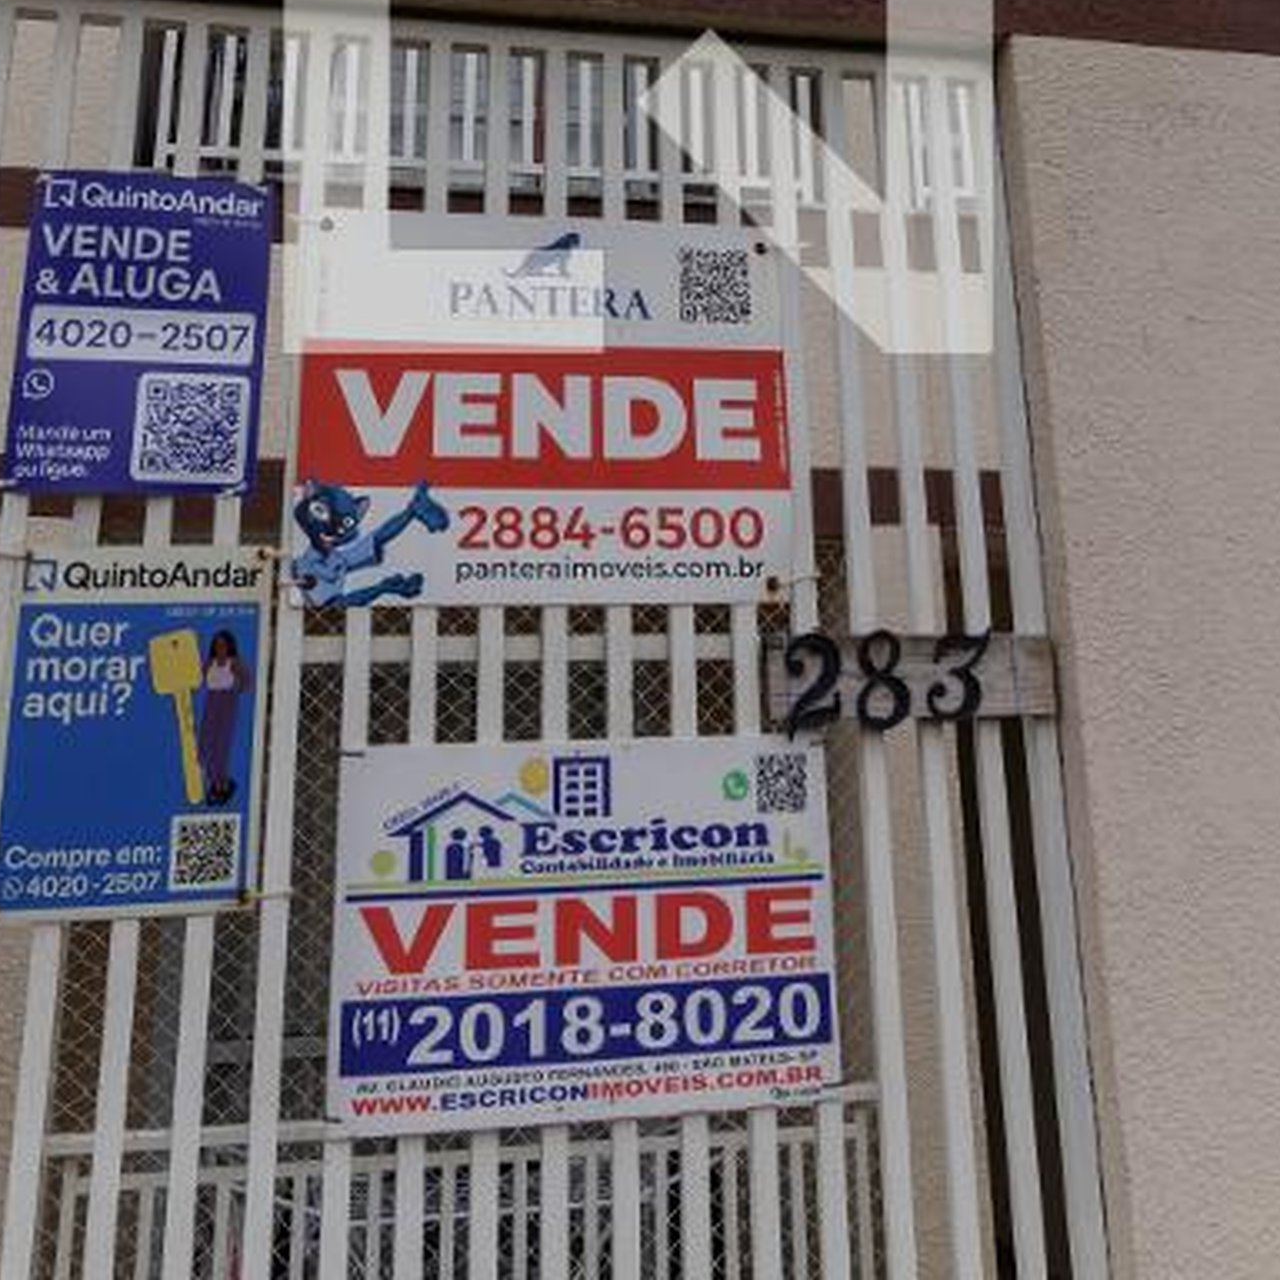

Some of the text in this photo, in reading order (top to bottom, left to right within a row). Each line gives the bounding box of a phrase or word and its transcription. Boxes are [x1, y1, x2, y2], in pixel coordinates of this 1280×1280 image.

[82, 181, 264, 217] QuintoAndar
[42, 223, 192, 262] VENDE
[35, 263, 221, 302] & ALUGA
[448, 280, 653, 320] PANTERA
[35, 318, 251, 352] 4020-2507
[334, 368, 763, 462] VENDE
[456, 506, 764, 551] 2884-6500
[63, 562, 261, 590] QuintoAndar
[455, 556, 766, 585] panteraimoveis.com.br
[29, 613, 130, 648] Quer
[26, 654, 145, 682] morar
[785, 629, 992, 738] 283
[21, 683, 133, 725] aqui?
[520, 817, 769, 857] Escricon
[4, 845, 162, 872] Compre em:
[360, 887, 817, 976] VENDE
[356, 955, 817, 996] VISITAS SOMENTE COM CORRETOR
[351, 980, 821, 1066] (11) 2018-8020
[351, 1065, 824, 1116] WWW.ESCRICONIMOVEIS.COM.BR
